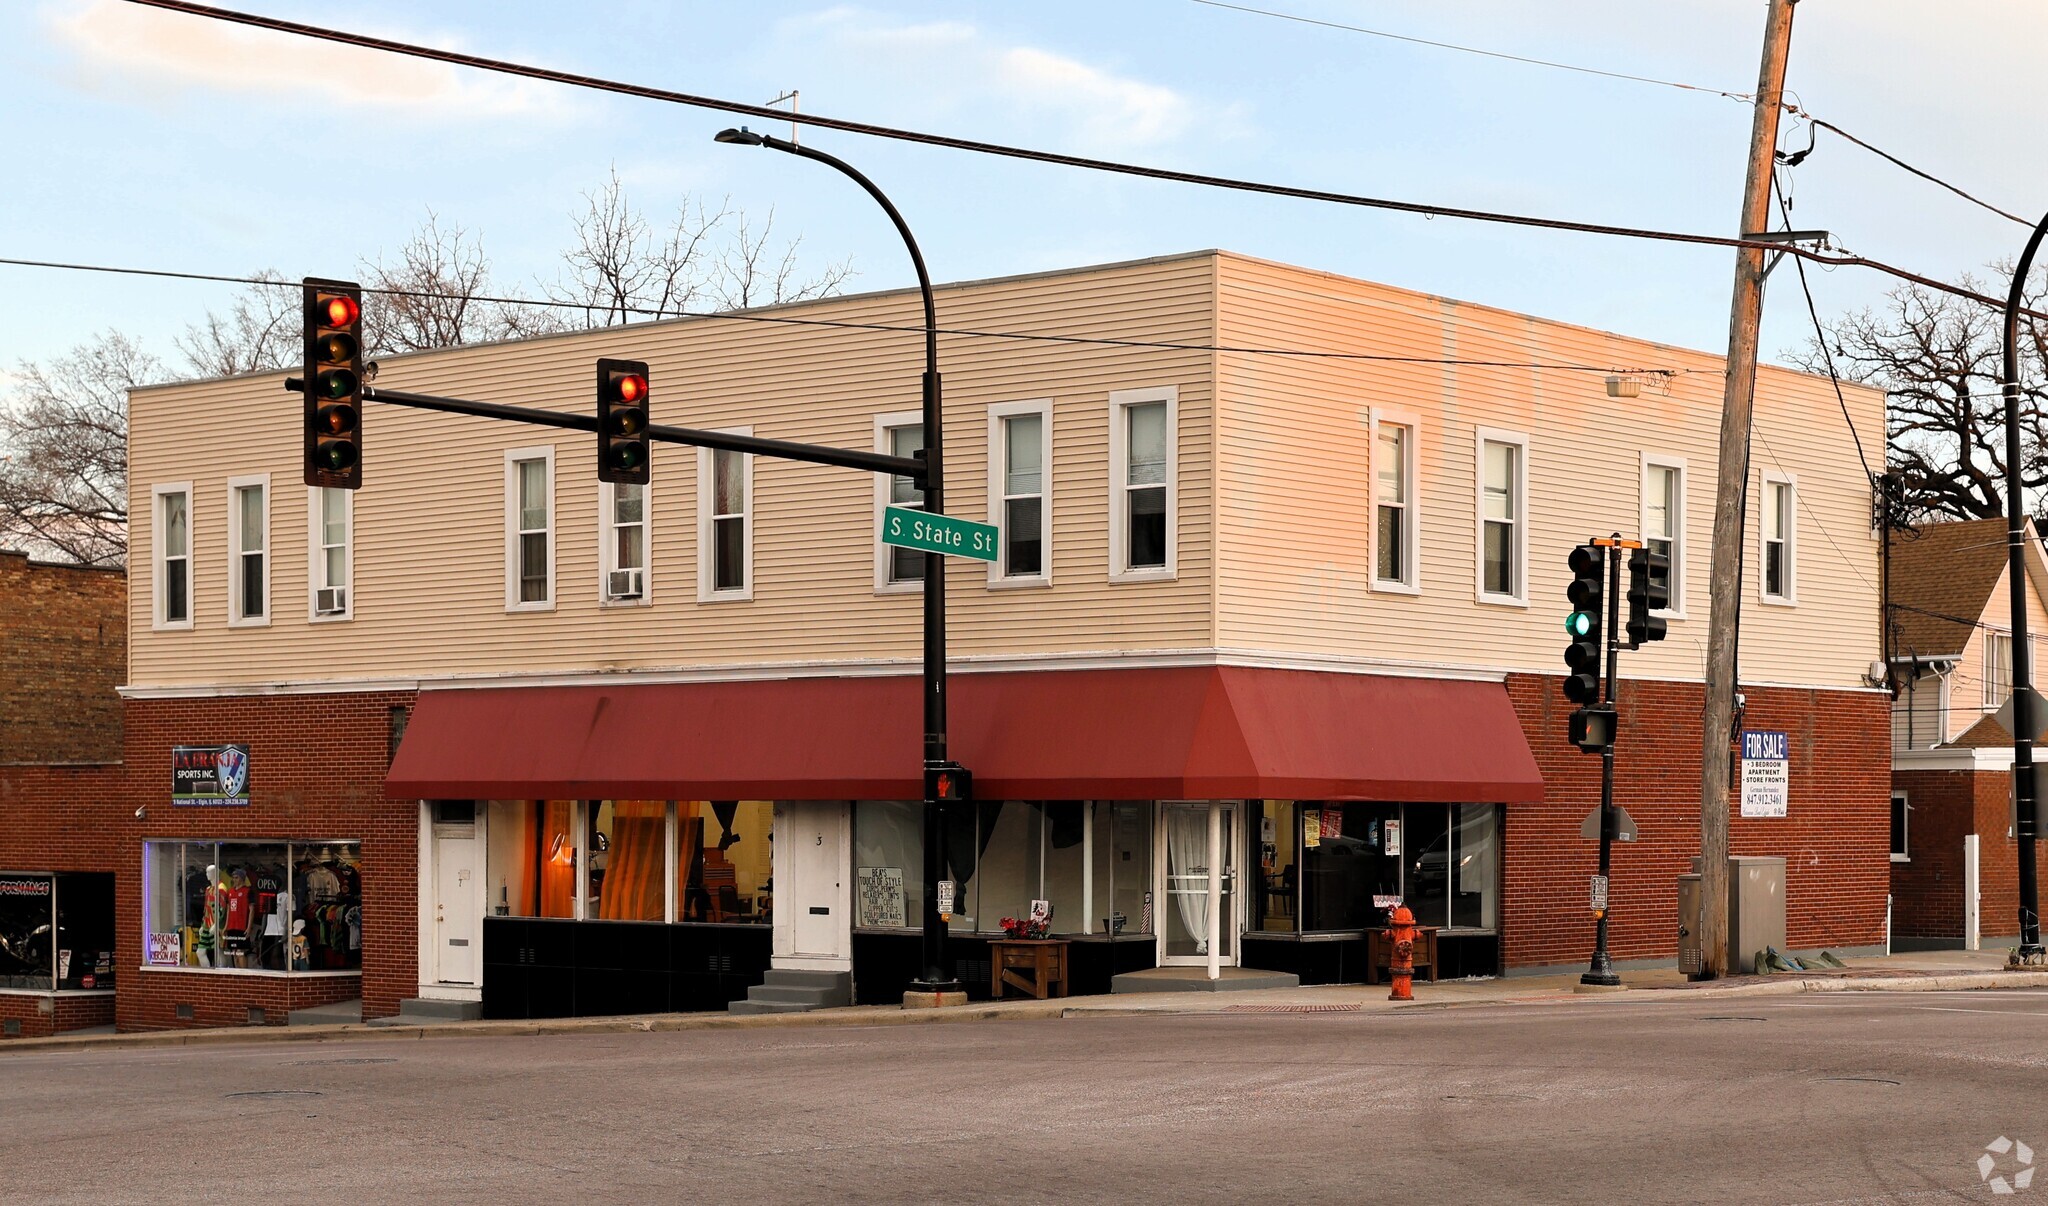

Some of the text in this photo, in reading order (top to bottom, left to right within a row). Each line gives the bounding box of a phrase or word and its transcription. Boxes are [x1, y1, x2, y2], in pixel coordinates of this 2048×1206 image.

[890, 517, 992, 552] S. State St
[1746, 733, 1784, 759] FOR SALE
[175, 753, 190, 768] LA
[177, 770, 215, 779] SPORTS INC.
[816, 837, 822, 846] 3
[872, 869, 887, 877] BEA'S
[258, 879, 277, 889] OPEN
[860, 877, 901, 886] TOUCH OF STYLE
[150, 934, 178, 945] PARKING
[294, 944, 301, 959] 9
